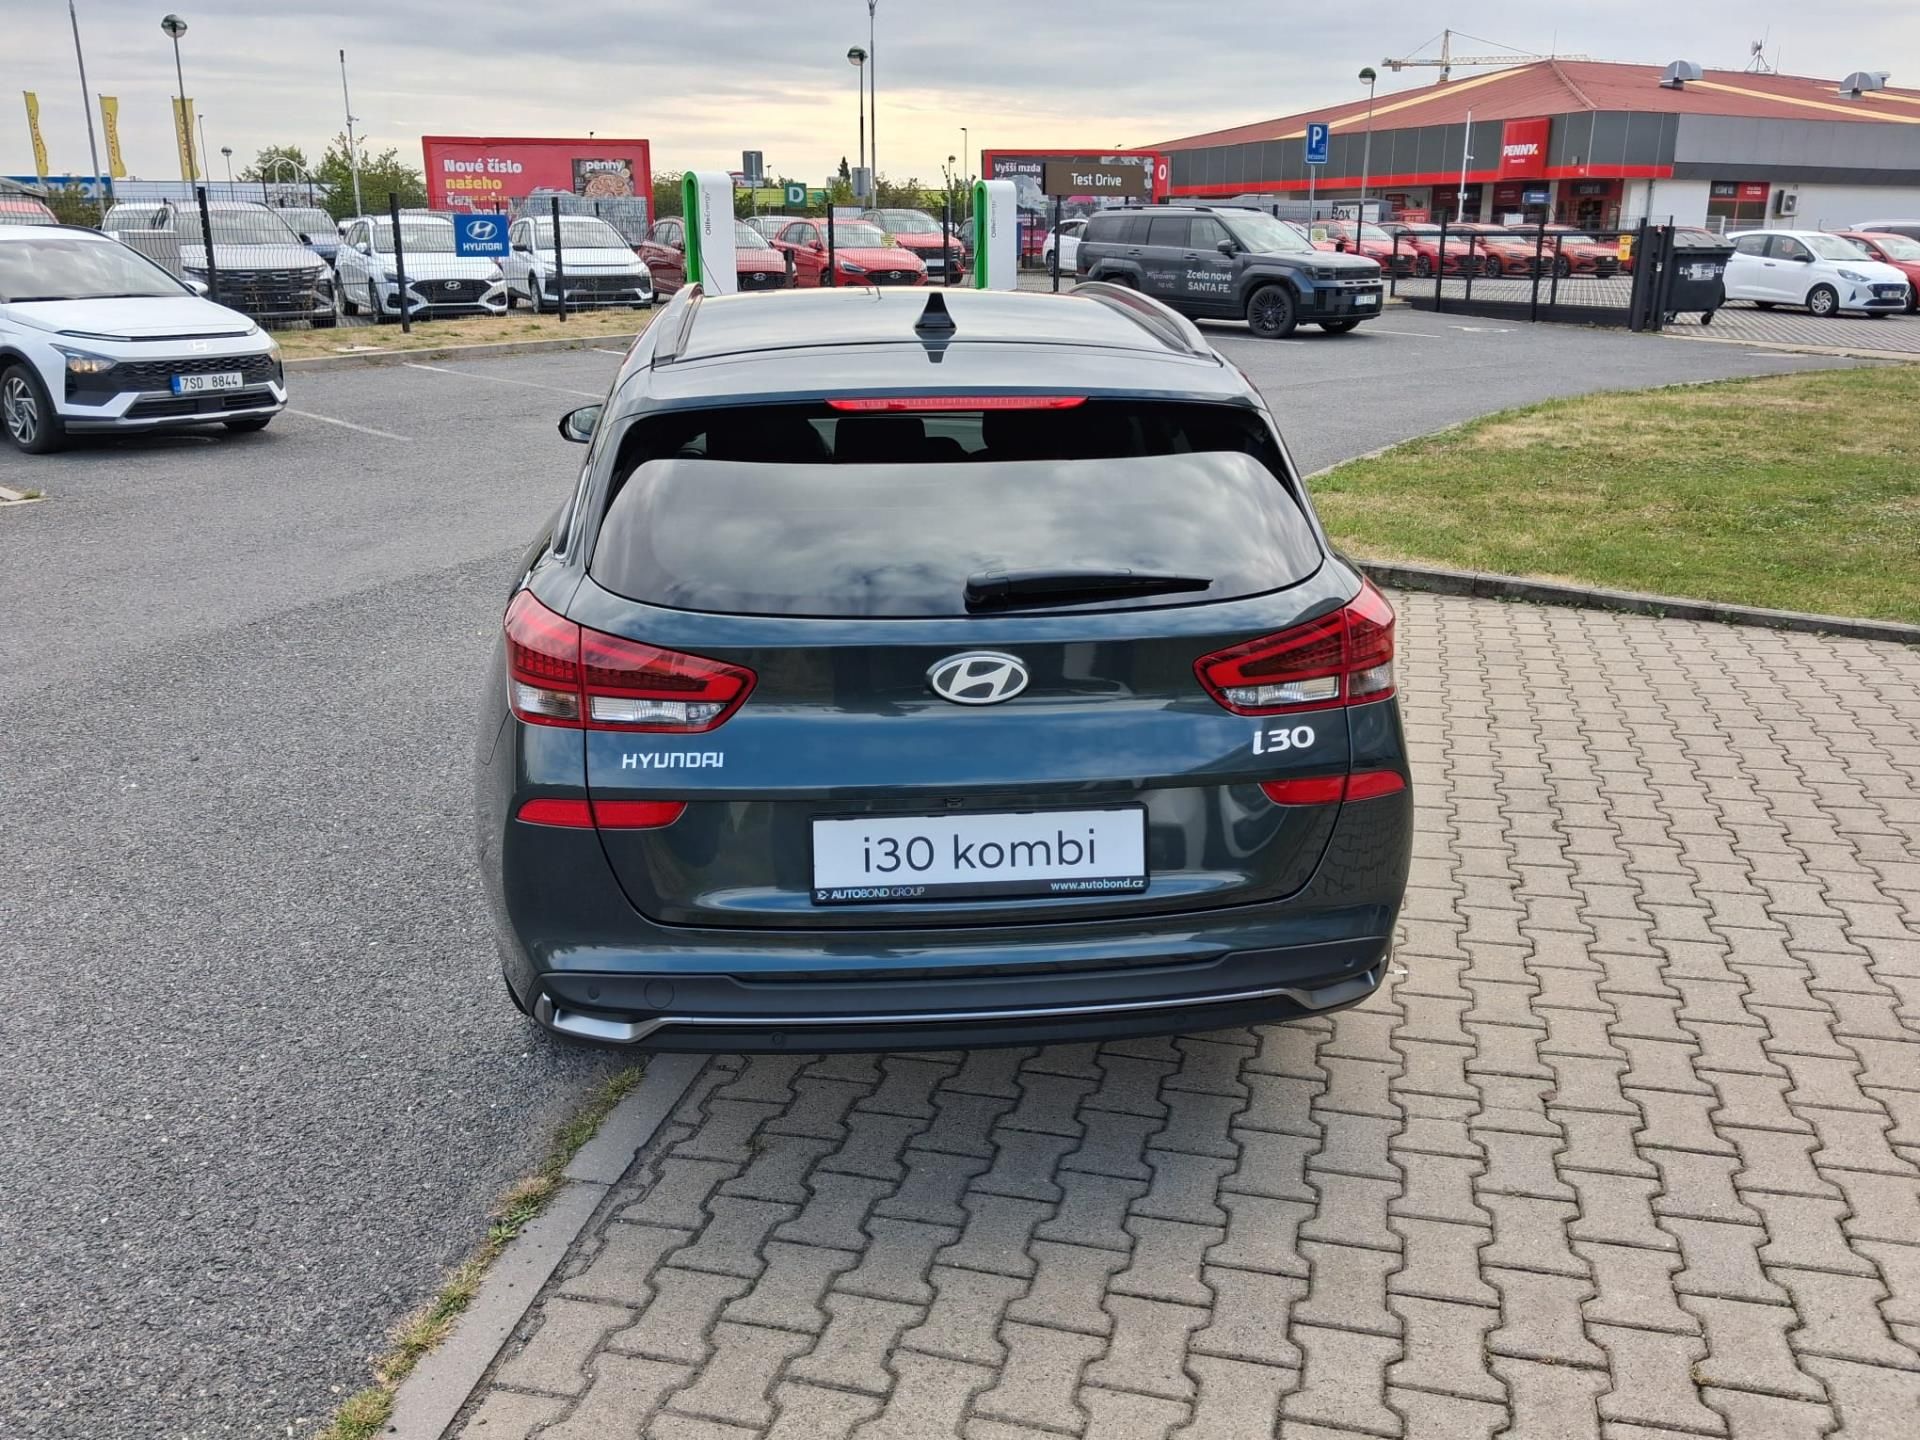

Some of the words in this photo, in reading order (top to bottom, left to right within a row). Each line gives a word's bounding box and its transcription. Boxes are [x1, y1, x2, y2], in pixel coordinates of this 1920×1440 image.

[1312, 126, 1322, 148] P
[443, 158, 484, 173] Nové
[486, 158, 523, 173] číslo
[585, 161, 622, 172] penny
[1018, 163, 1041, 172] mzda
[445, 175, 503, 190] našeho
[1071, 173, 1093, 186] Test
[1095, 173, 1122, 187] Drive
[788, 186, 805, 203] D
[462, 242, 503, 251] HYUNDAI
[1186, 269, 1209, 279] Zcela
[1210, 270, 1232, 281] nové
[1187, 281, 1217, 292] SANTA
[182, 377, 204, 390] 7SD
[211, 374, 238, 388] 8844
[622, 752, 724, 769] HYUNDAI
[863, 836, 935, 873] i30
[953, 828, 1096, 870] kombi
[1050, 877, 1145, 891] www.autobond.cz
[831, 887, 890, 900] AUTOBOND
[890, 886, 925, 897] GROUP
